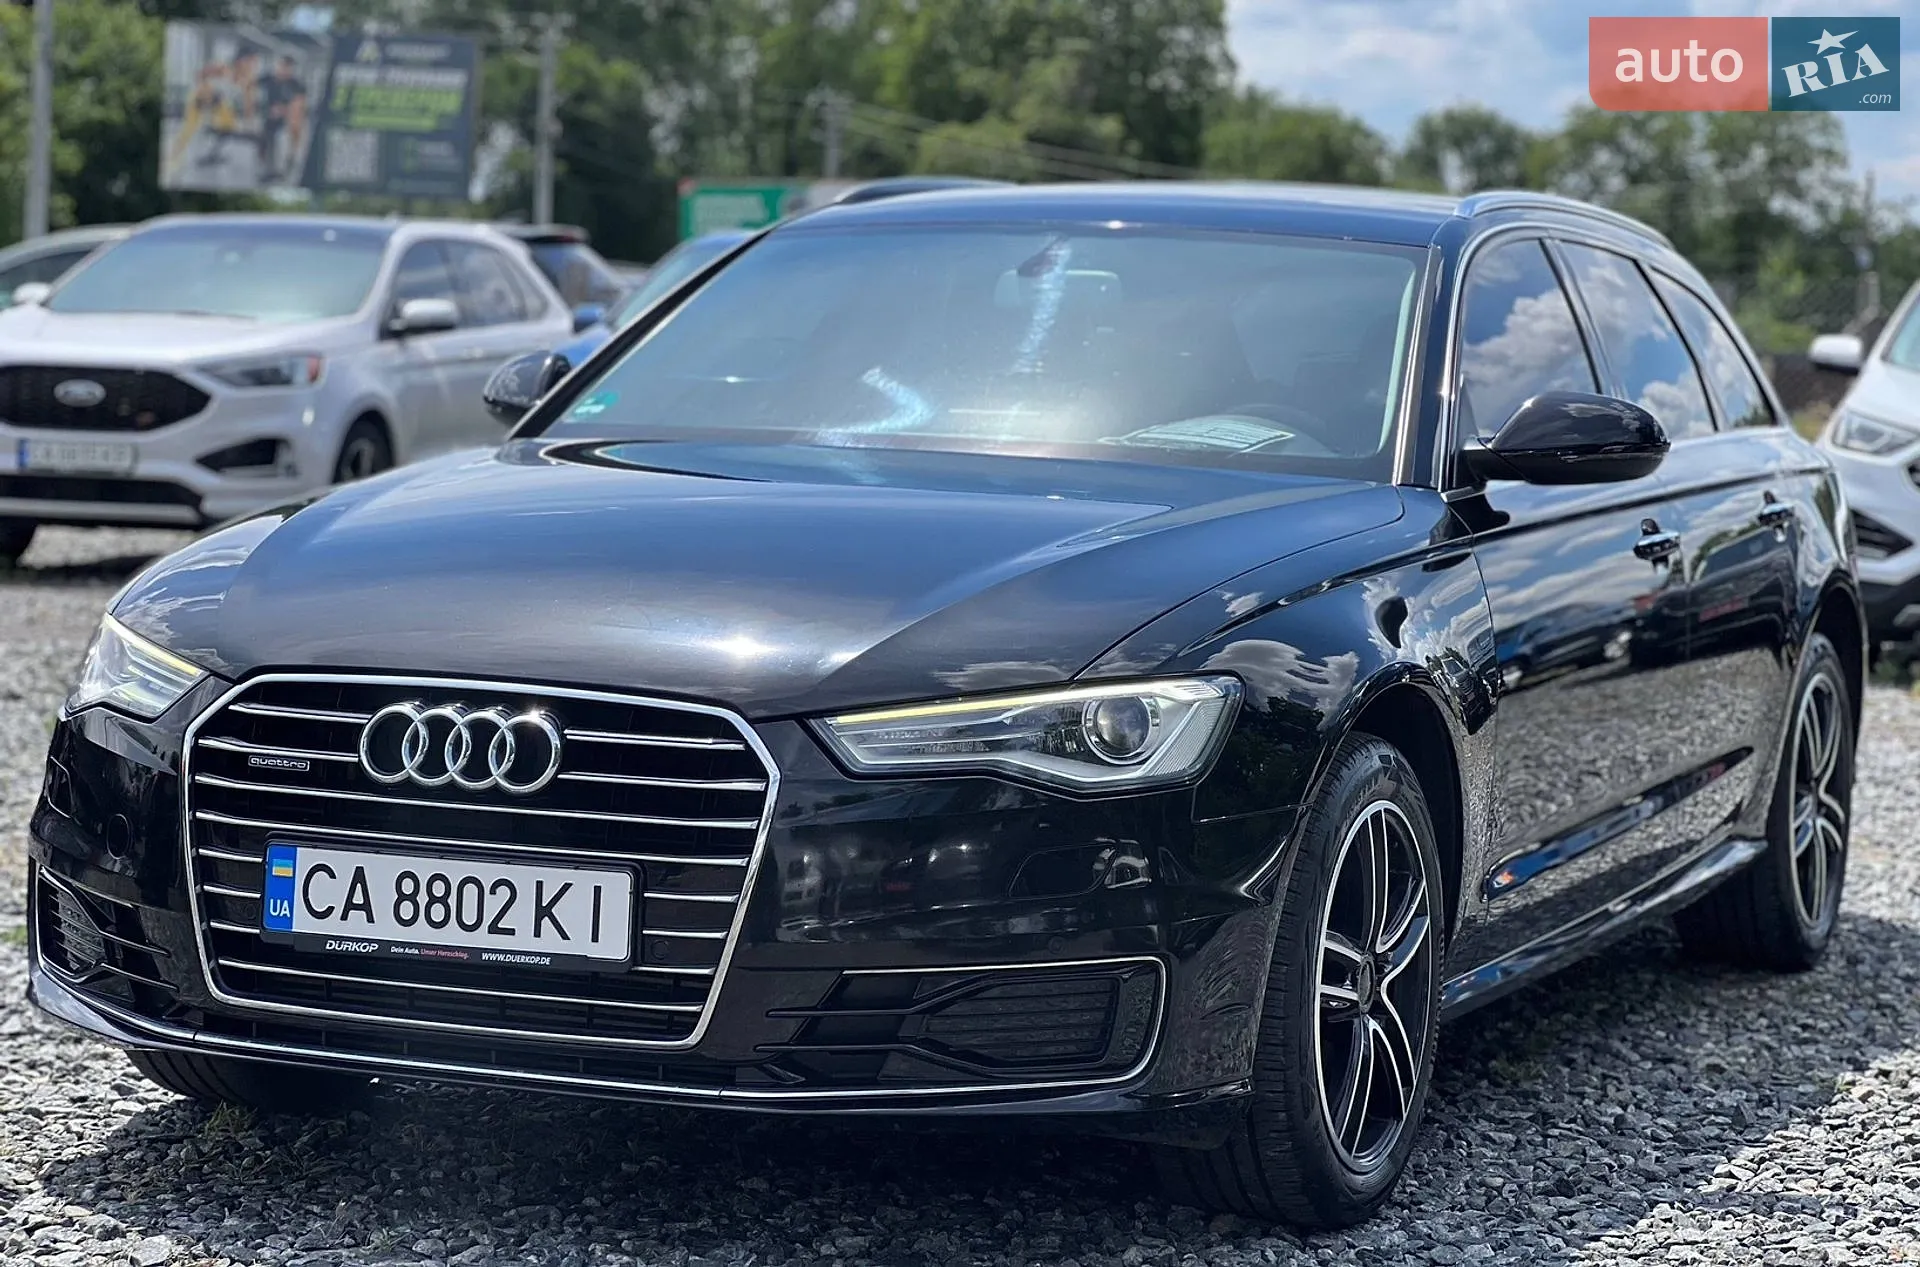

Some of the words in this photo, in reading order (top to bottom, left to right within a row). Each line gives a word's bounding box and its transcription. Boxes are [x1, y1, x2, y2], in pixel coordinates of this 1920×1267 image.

[250, 757, 307, 769] quattro
[269, 897, 291, 918] UA
[302, 863, 376, 924] CA
[392, 869, 518, 936] 8802
[481, 952, 551, 966] WWW.DUERKOP.DE
